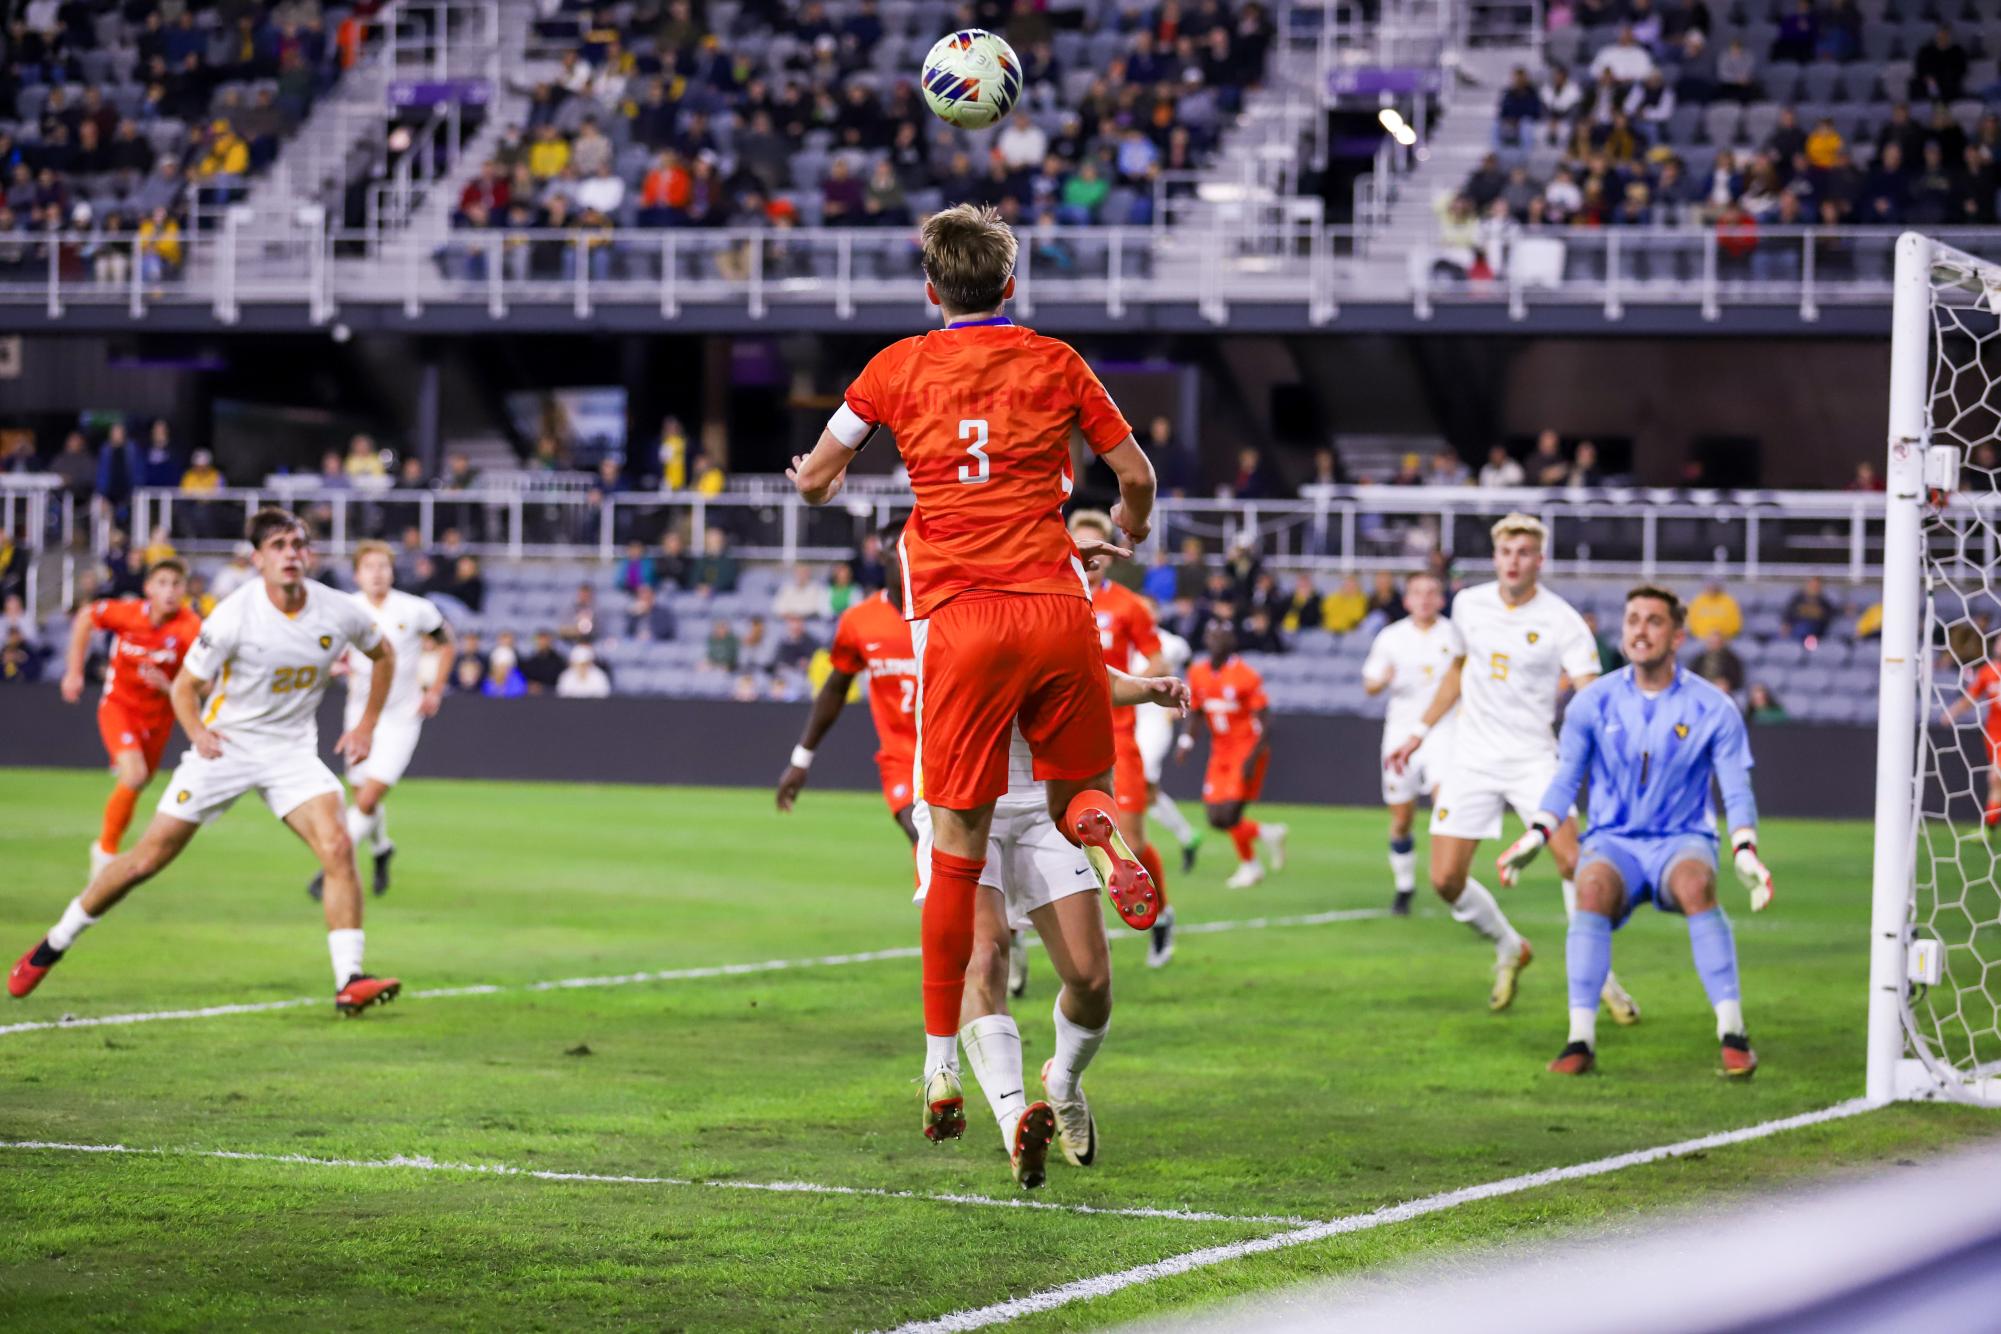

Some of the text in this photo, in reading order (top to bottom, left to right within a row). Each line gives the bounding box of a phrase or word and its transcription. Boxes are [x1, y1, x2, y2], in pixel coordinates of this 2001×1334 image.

[958, 419, 990, 485] 3
[272, 665, 318, 694] 20
[1490, 652, 1510, 682] 5
[900, 679, 915, 713] 2
